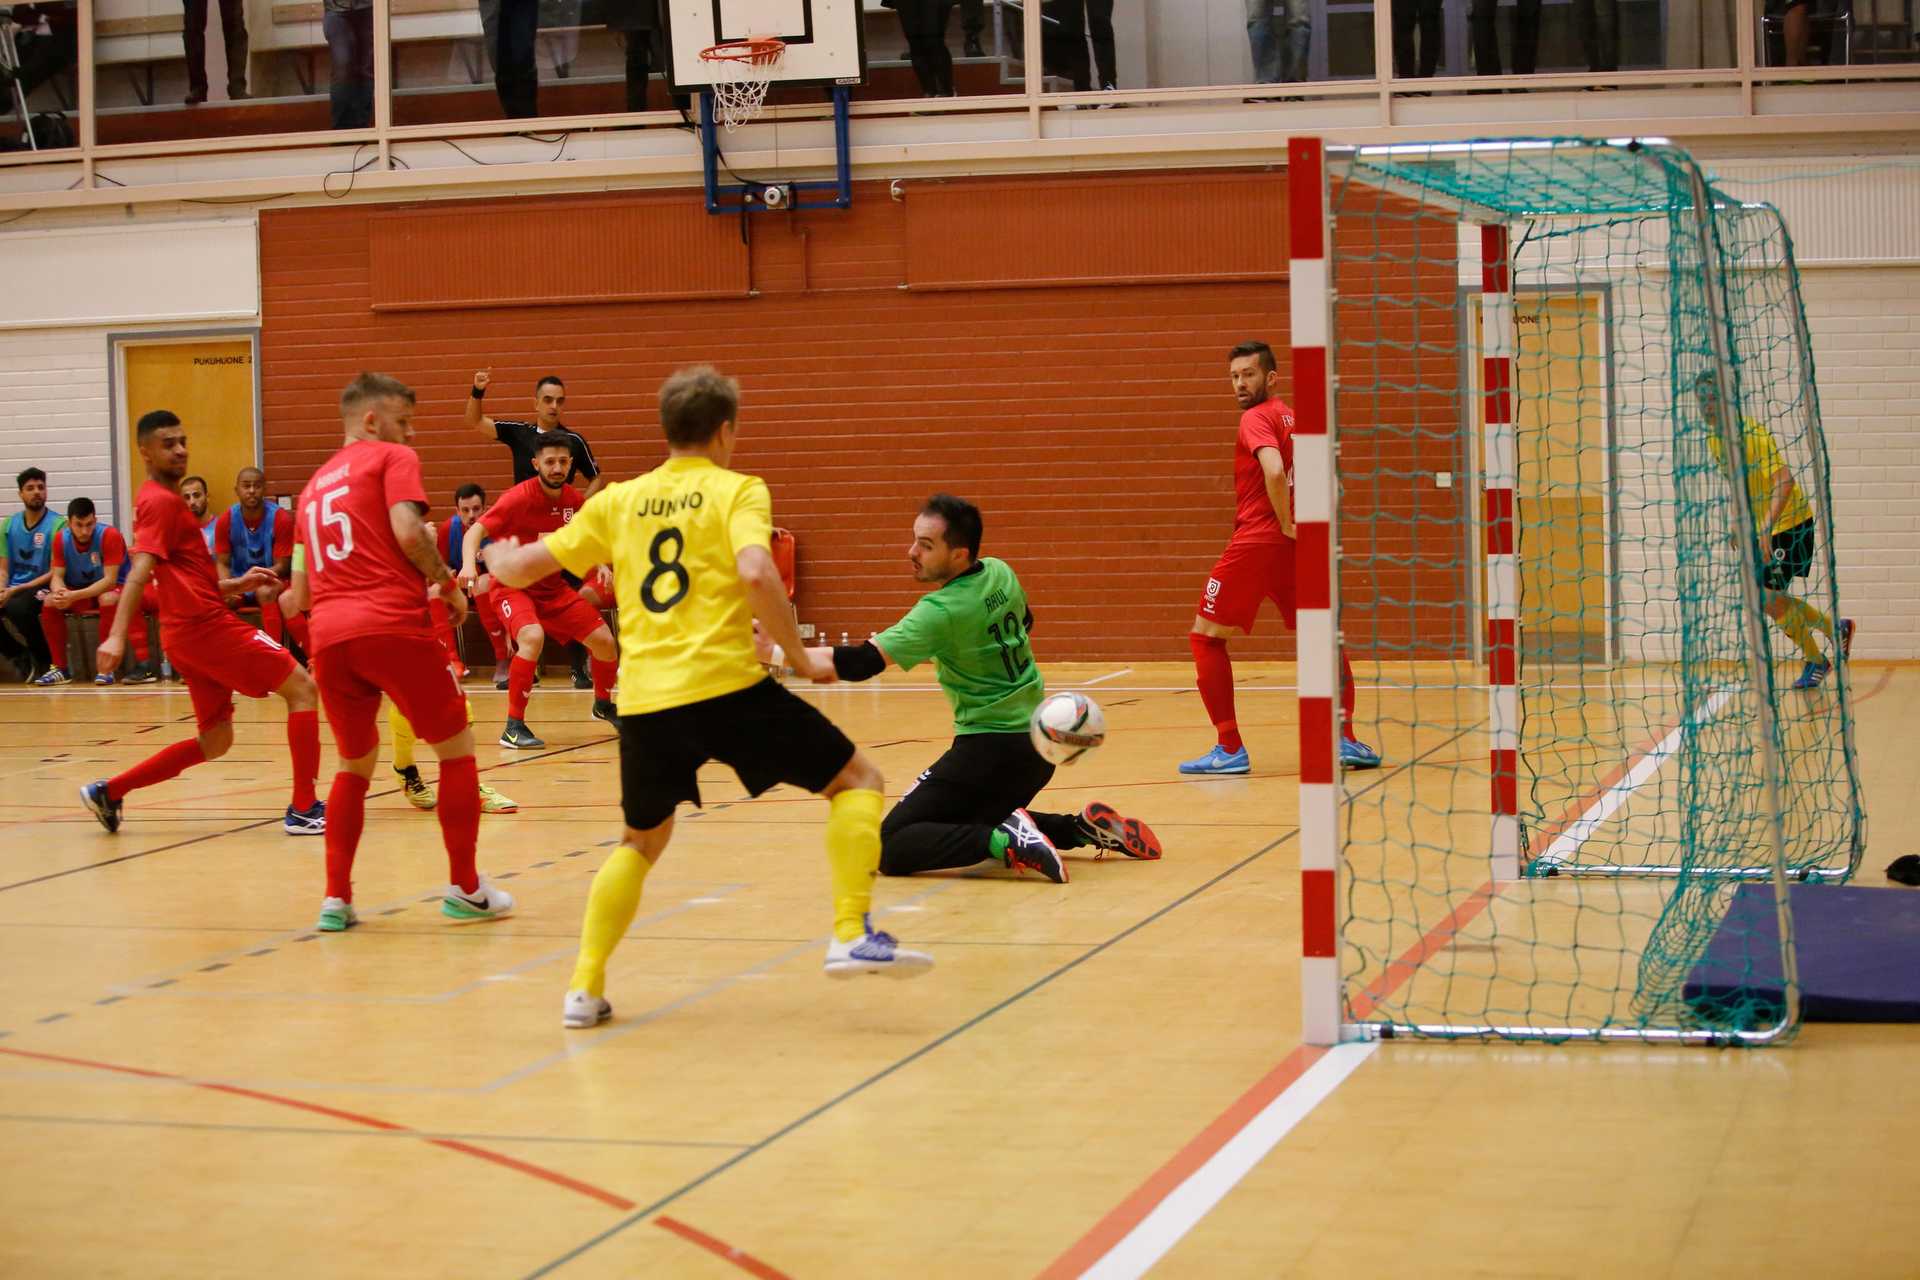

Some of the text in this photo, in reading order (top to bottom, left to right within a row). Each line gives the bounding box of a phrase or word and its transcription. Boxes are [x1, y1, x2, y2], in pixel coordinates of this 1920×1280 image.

[193, 356, 243, 366] PUKUHUONE
[305, 485, 354, 573] 15
[641, 526, 690, 614] 8
[502, 599, 512, 618] 6
[988, 611, 1031, 683] 12
